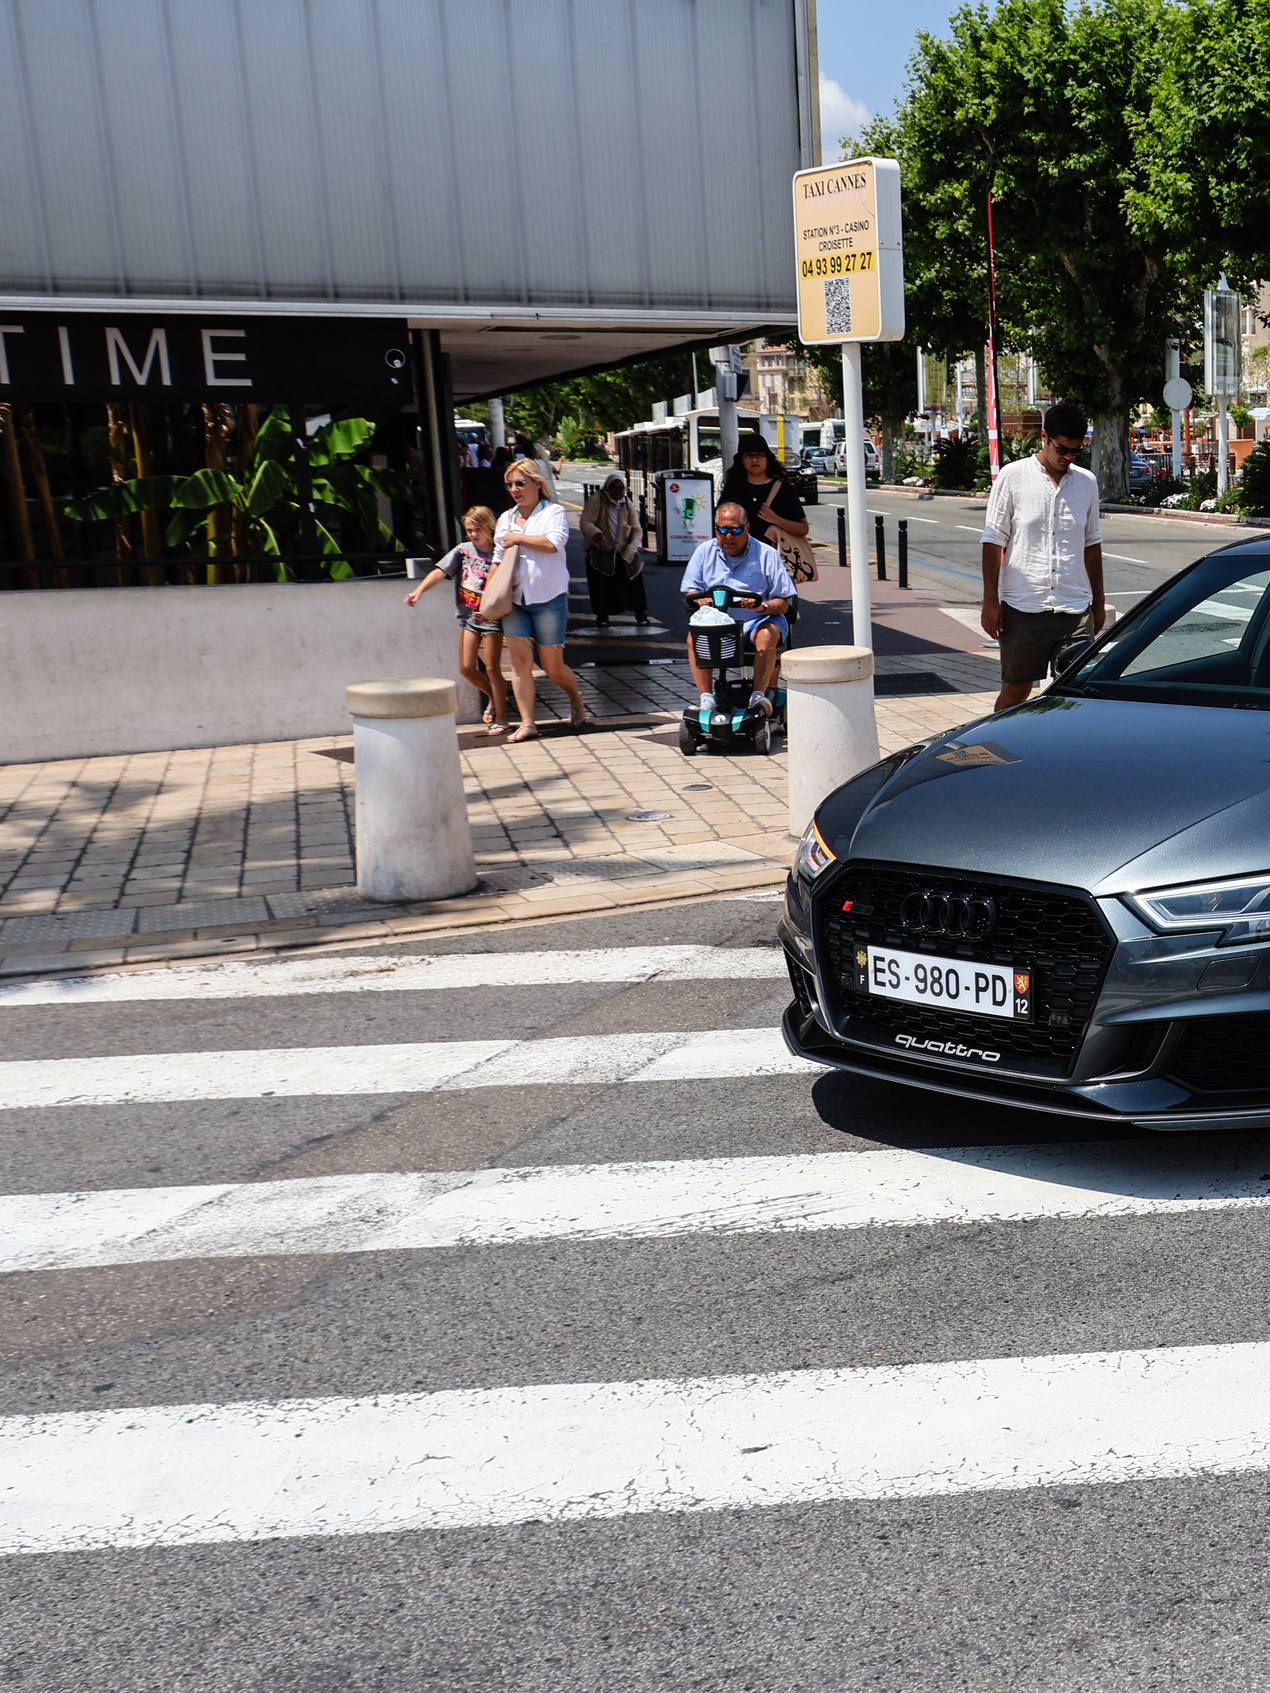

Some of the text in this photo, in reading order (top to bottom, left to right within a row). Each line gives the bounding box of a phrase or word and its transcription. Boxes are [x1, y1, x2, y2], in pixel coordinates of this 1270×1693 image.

[803, 173, 866, 199] TAXI CANNES
[803, 226, 828, 240] STATION
[844, 220, 870, 232] CASINO
[819, 237, 853, 252] CROISETTE
[802, 252, 872, 278] 04 93 99 27 27
[0, 325, 253, 387] TIME
[860, 974, 865, 985] F
[873, 956, 1007, 1007] ES-980-PD
[1015, 997, 1029, 1015] 12
[895, 1033, 1001, 1062] quattro
